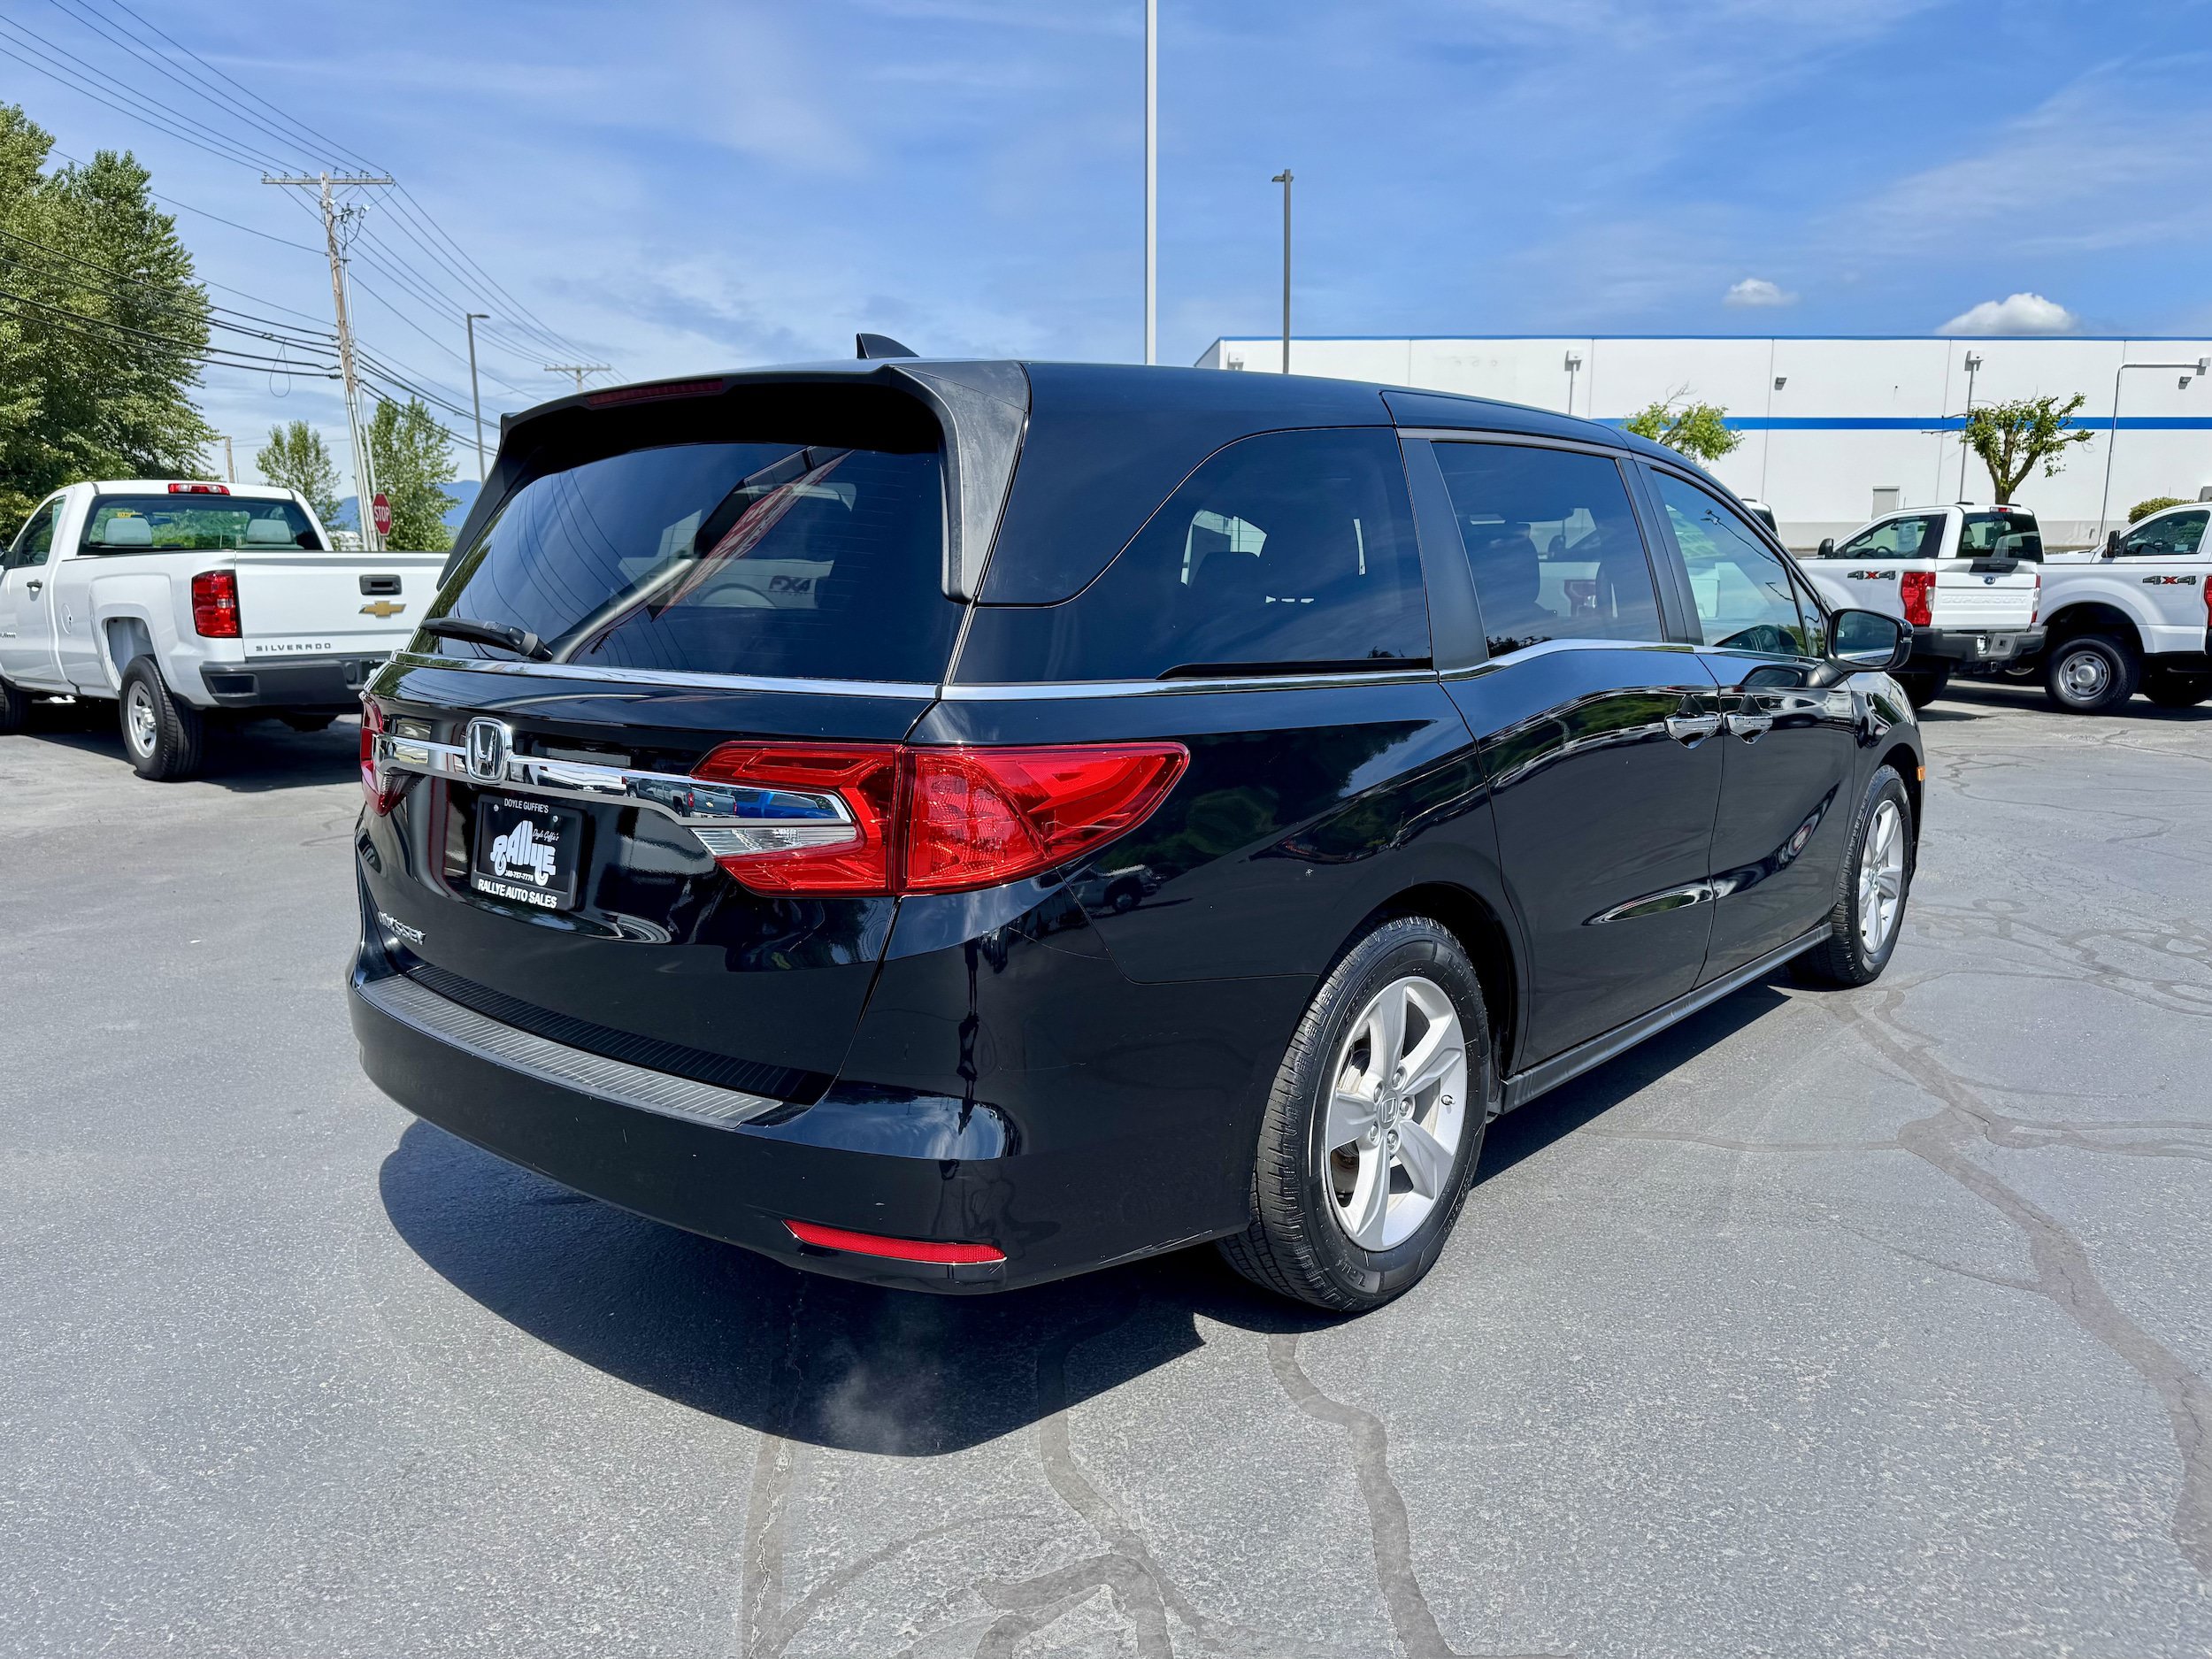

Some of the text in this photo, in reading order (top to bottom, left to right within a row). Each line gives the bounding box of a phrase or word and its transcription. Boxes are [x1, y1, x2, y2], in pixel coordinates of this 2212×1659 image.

[374, 505, 389, 522] STOP
[256, 642, 332, 652] SILVERADO
[504, 797, 549, 814] DOYLE GUFFIE'S
[477, 878, 558, 909] RALLYE AUTO SALES
